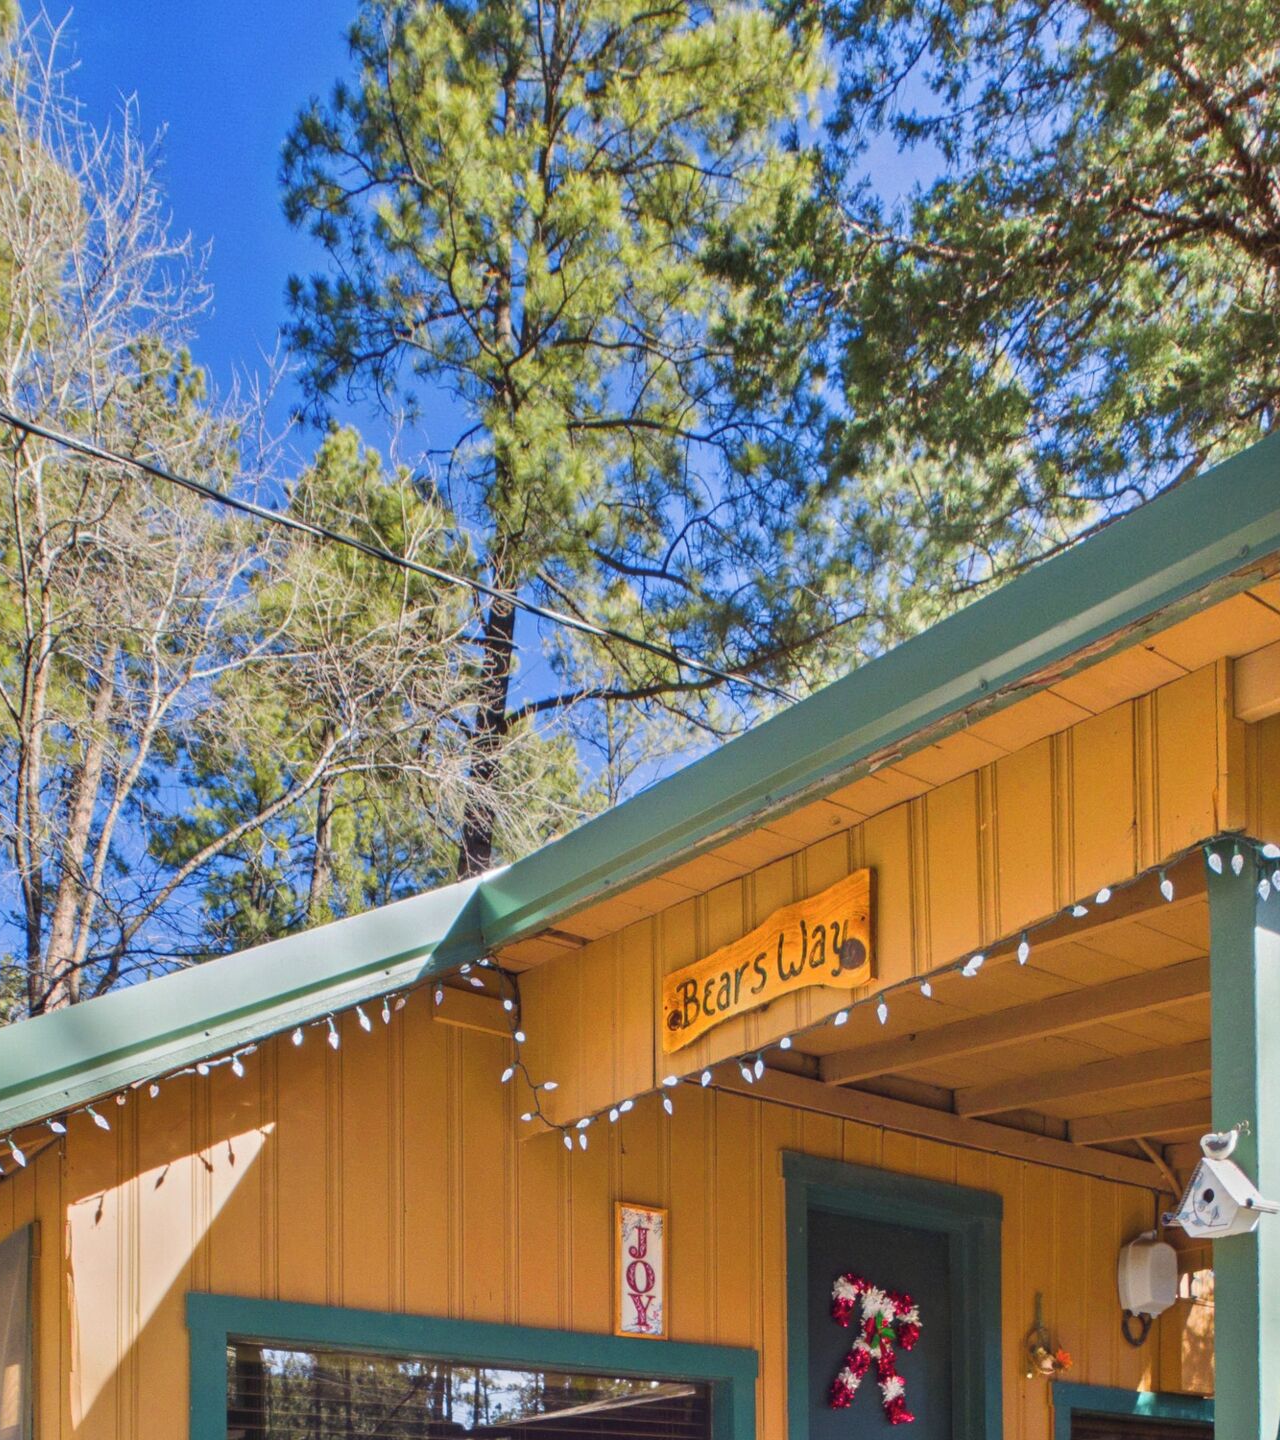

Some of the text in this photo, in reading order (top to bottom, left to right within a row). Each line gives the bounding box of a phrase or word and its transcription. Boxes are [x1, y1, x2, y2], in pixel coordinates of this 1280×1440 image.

[676, 919, 850, 1030] Bears Way
[626, 1227, 656, 1327] JOY
